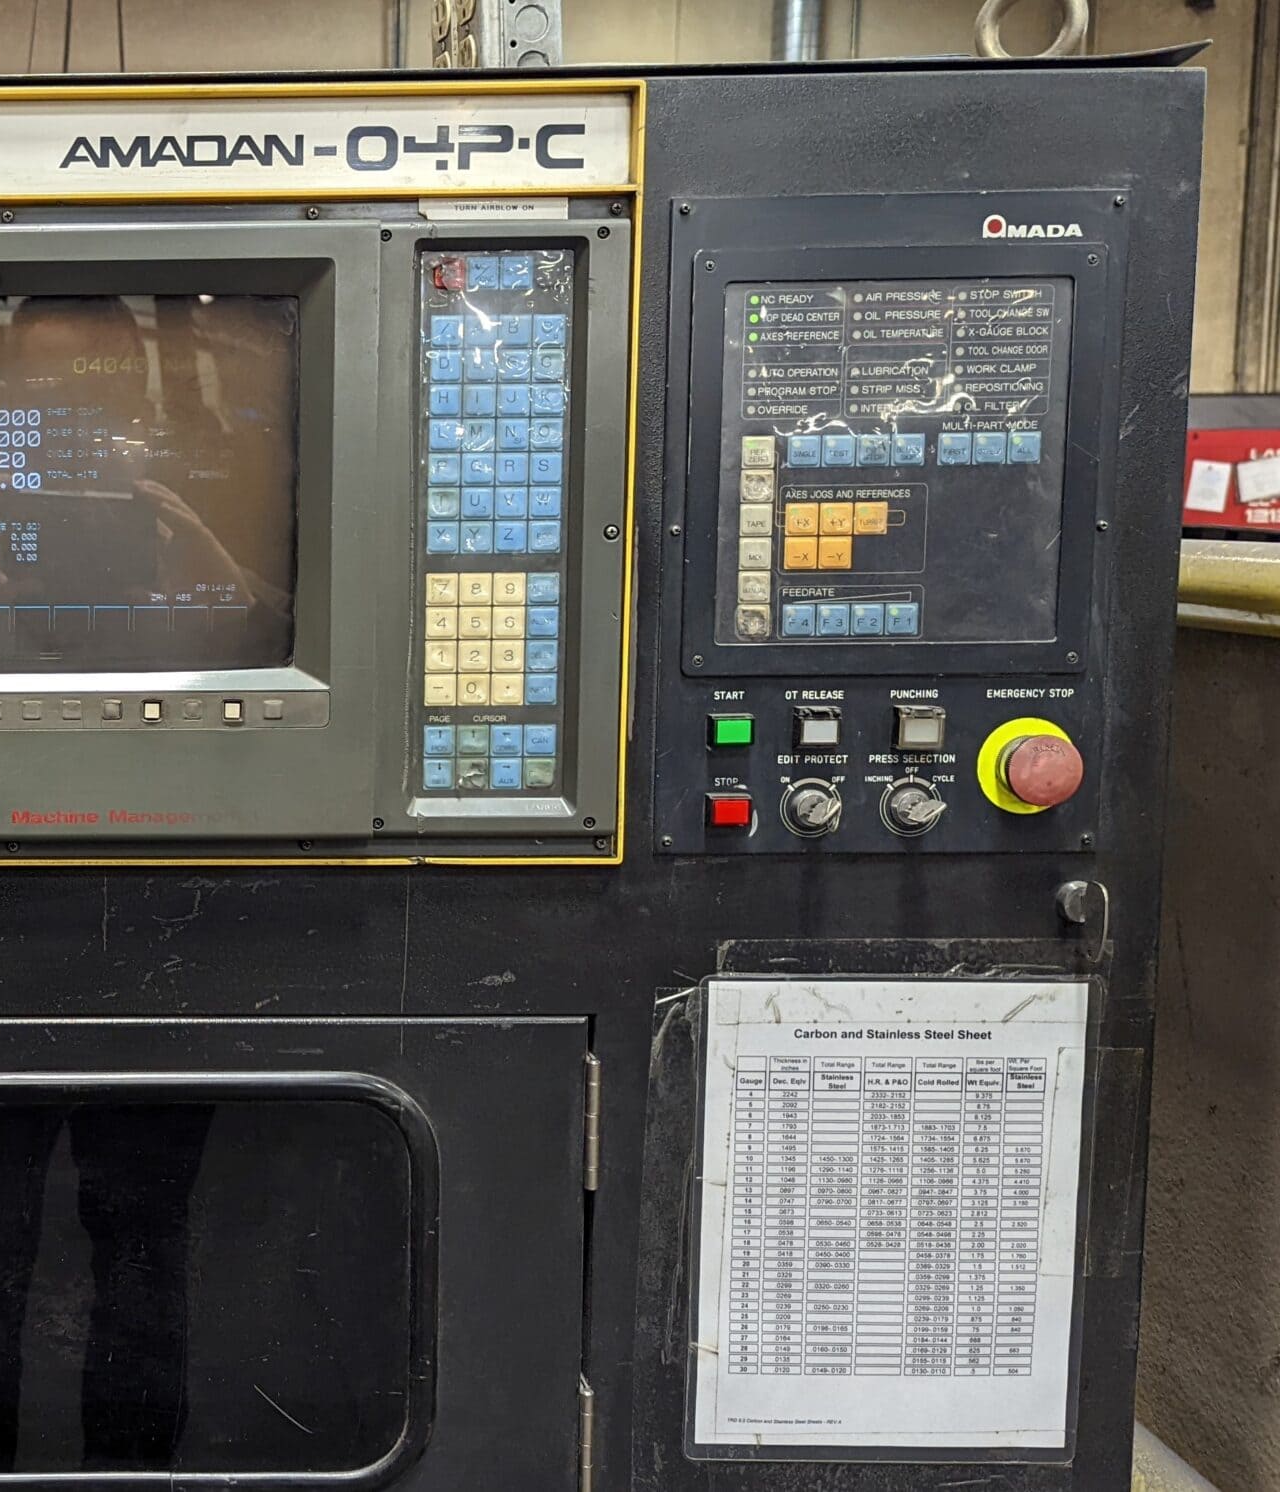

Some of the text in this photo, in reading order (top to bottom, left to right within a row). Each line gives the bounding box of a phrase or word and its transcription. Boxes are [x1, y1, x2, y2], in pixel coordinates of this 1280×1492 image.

[522, 203, 535, 211] ON
[761, 295, 814, 304] NC READY
[865, 291, 942, 301] AIR PRESSURE
[970, 290, 999, 299] STOP
[781, 313, 804, 322] DEAD
[806, 312, 840, 322] CENTER
[864, 310, 941, 320] OIL PRESSURE
[969, 308, 1050, 318] TOOL CHANGE SW
[760, 331, 840, 341] AXES REFERENCE
[863, 329, 944, 339] OIL TEMPERATURE
[968, 327, 1049, 337] X-GAUGE BLOCK
[968, 345, 1048, 355] TOOL CHANGE DOOR
[787, 367, 838, 377] OPERATION
[862, 366, 929, 376] LUBRICATION
[966, 364, 1037, 374] WORK CLAMP
[758, 386, 837, 396] PROGRAM STOP
[862, 384, 920, 394] STRIP MISS
[965, 382, 1043, 392] REPOSITIONING
[758, 405, 808, 415] OVERRIDE
[984, 401, 1020, 411] FILTER
[942, 421, 1038, 430] MULTI-PART MODE
[785, 488, 911, 499] AXES JOGS AND REFERENCES
[746, 520, 767, 528] TAPE
[11, 533, 38, 541] 0.000
[11, 543, 38, 551] 0.000
[16, 553, 38, 562] 0.00
[471, 582, 482, 596] 8
[505, 582, 516, 595] 9
[782, 588, 835, 597] FEEDRATE
[436, 616, 447, 629] 4
[470, 616, 482, 629] 5
[504, 616, 516, 629] 6
[469, 650, 481, 663] 2
[503, 649, 515, 662] 3
[466, 681, 477, 694] 0
[714, 691, 745, 700] START
[802, 690, 845, 699] RELEASE
[890, 689, 939, 699] PUNCHING
[986, 688, 1074, 698] EMERGENCY STOP
[429, 715, 451, 723] PAGE
[473, 715, 507, 723] CURSOR
[777, 755, 848, 764] EDIT PROTECT
[869, 754, 956, 763] PRESS SELECTION
[905, 766, 919, 774] OFF
[714, 777, 739, 786] STOP
[12, 810, 99, 825] Machine
[794, 1029, 992, 1040] Carbon and Stainless Steel Sheet
[739, 1078, 763, 1086] Gauge
